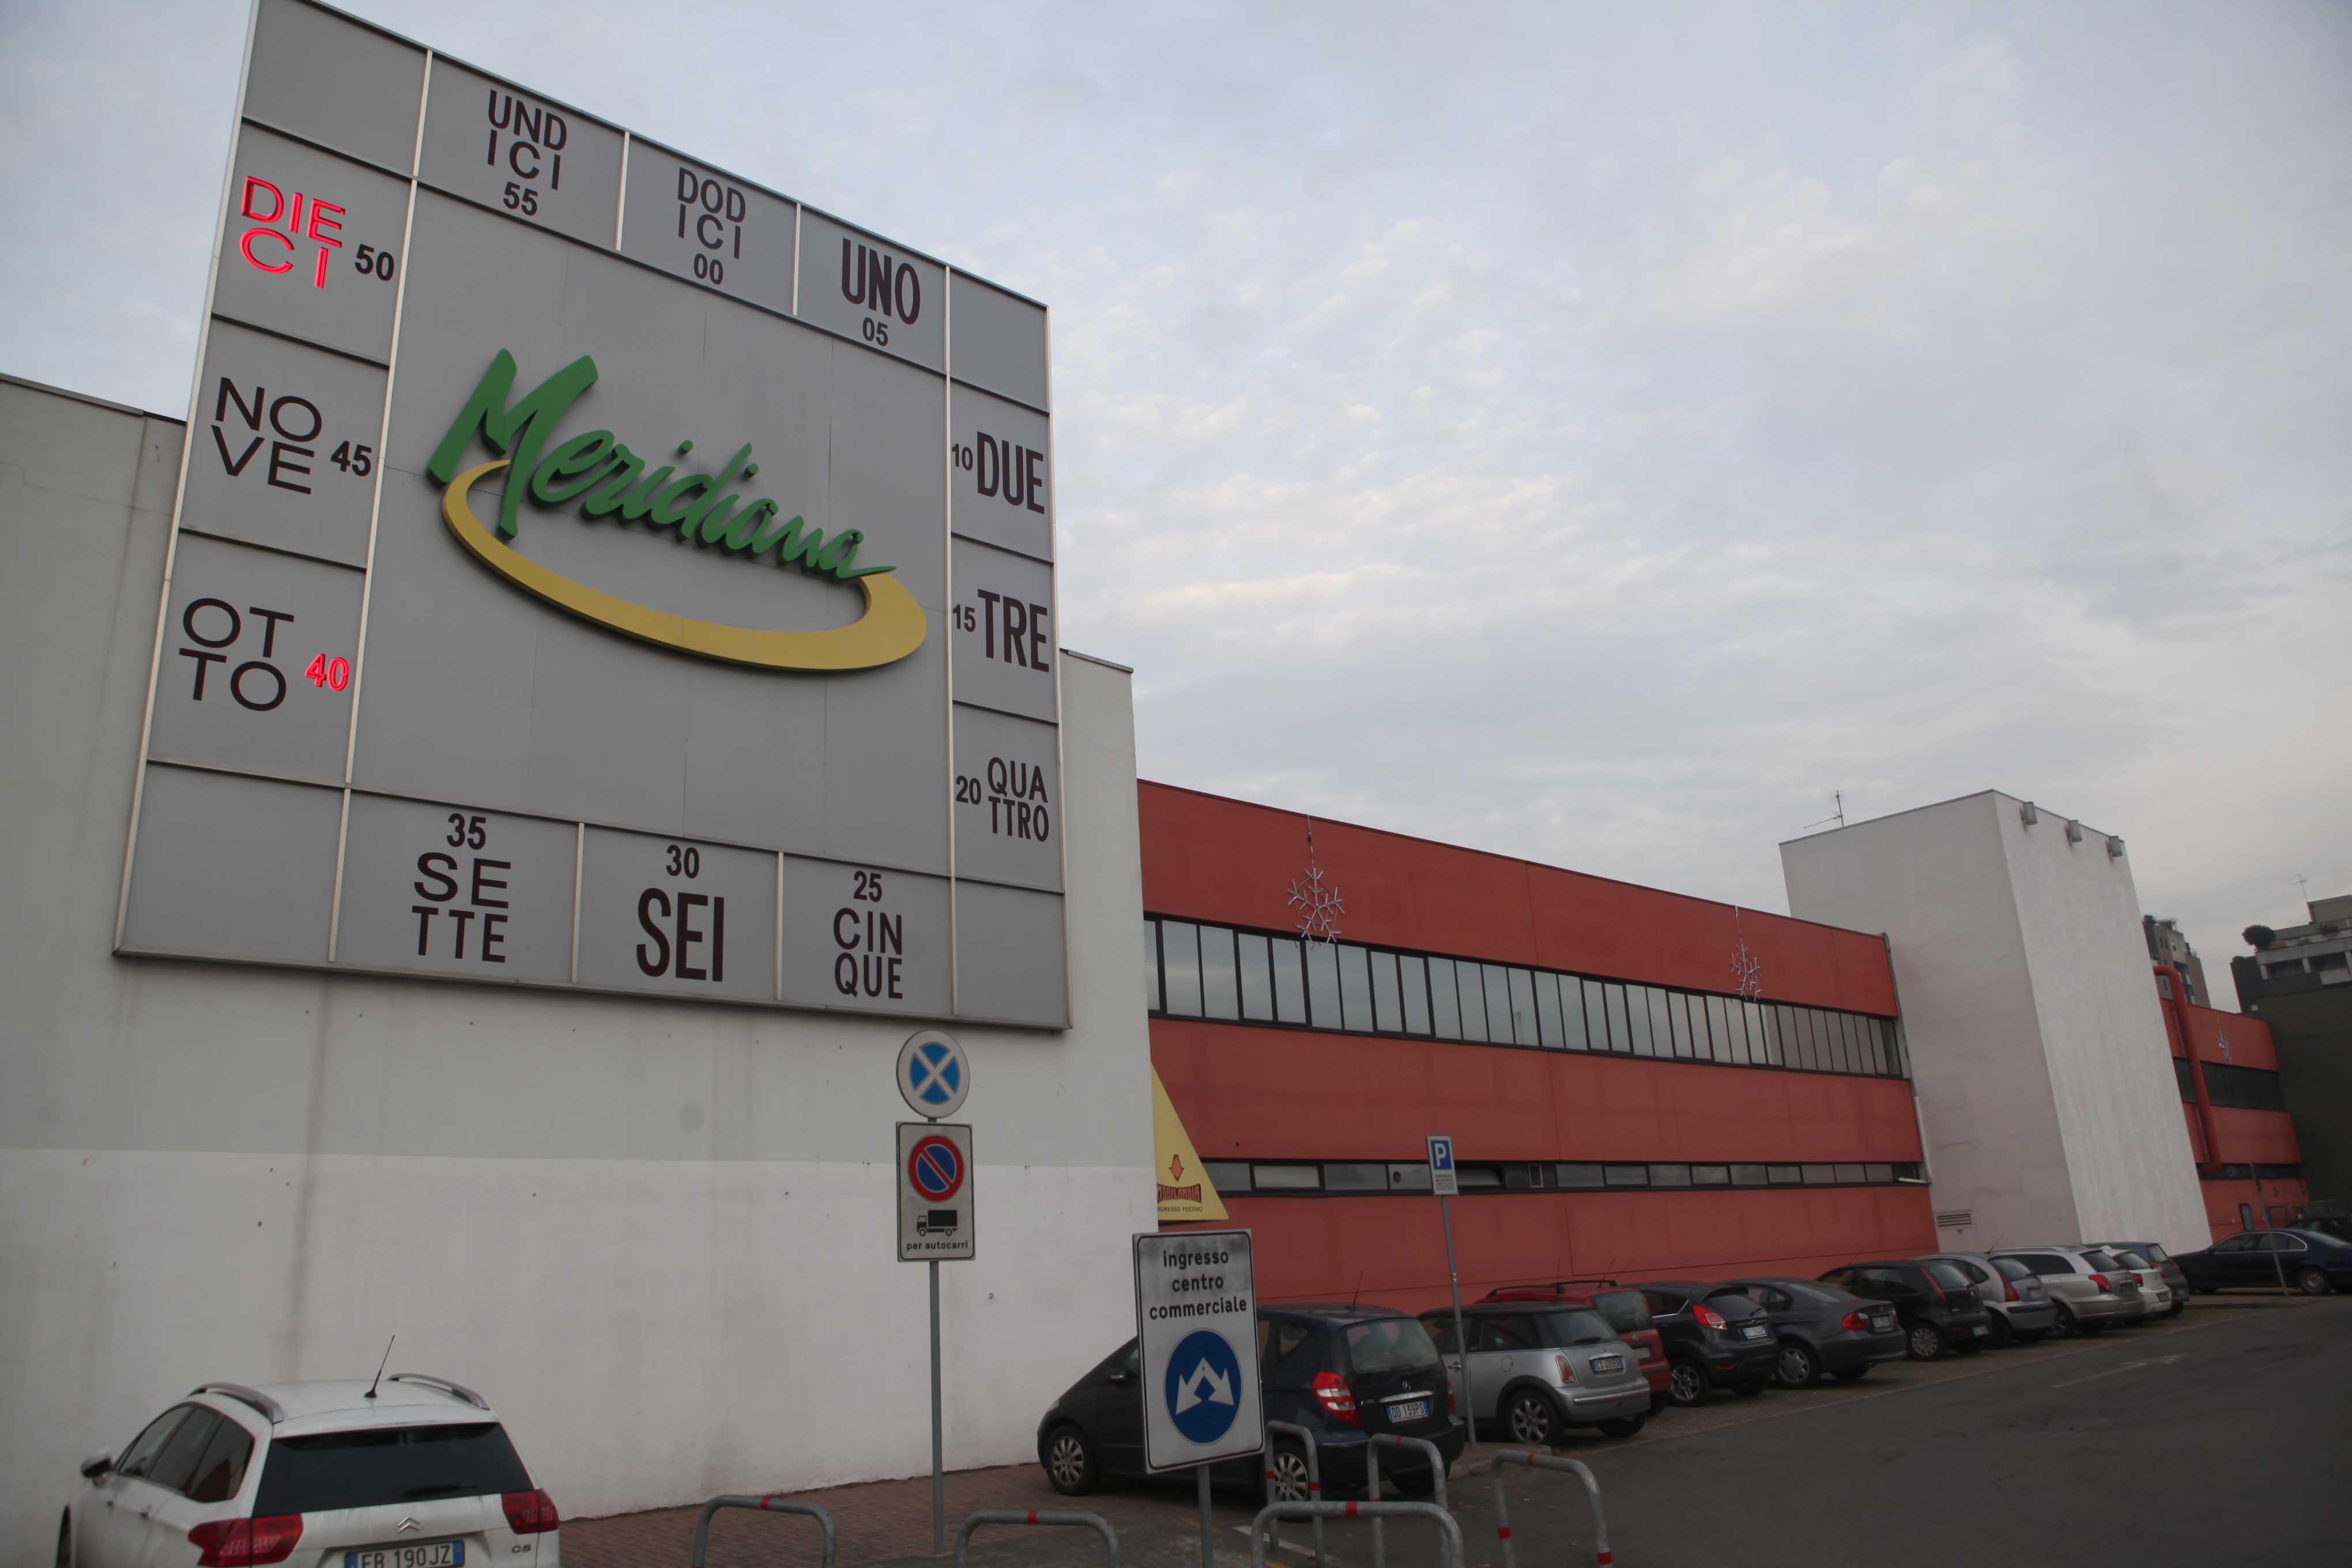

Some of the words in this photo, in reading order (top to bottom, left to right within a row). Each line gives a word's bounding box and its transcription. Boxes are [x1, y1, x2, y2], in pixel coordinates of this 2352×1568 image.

[488, 89, 567, 150] UND
[487, 129, 561, 190] ICI
[240, 175, 346, 248] DIE
[503, 182, 538, 215] 55
[677, 167, 745, 223] DOD
[678, 204, 741, 259] ICI
[239, 228, 329, 289] CI
[355, 244, 395, 281] 50
[693, 254, 723, 284] 00
[841, 238, 921, 325] UNO
[863, 317, 888, 346] 05
[215, 376, 322, 443] NO
[211, 424, 315, 495] VE
[331, 440, 372, 477] 45
[426, 348, 897, 578] Meridiana
[952, 443, 973, 471] 10
[977, 431, 1045, 514] DUE
[183, 598, 295, 658] OT
[953, 604, 976, 632] 15
[978, 589, 1050, 673] TRE
[179, 648, 287, 711] TO
[304, 653, 349, 691] 40
[956, 776, 981, 805] 20
[987, 757, 1048, 804] QUA
[446, 813, 487, 850] 35
[988, 796, 1049, 842] TTRO
[414, 852, 511, 909] SE
[666, 845, 699, 879] 30
[853, 870, 882, 902] 25
[412, 905, 508, 963] TTE
[636, 888, 725, 982] SEI
[833, 907, 902, 955] CIN
[834, 953, 903, 1000] QUE
[1434, 1143, 1446, 1167] P
[907, 1243, 922, 1251] per
[925, 1241, 968, 1249] autocarri
[1163, 1250, 1228, 1269] ingresso
[1173, 1273, 1223, 1292] centro
[1149, 1296, 1246, 1320] commerciale
